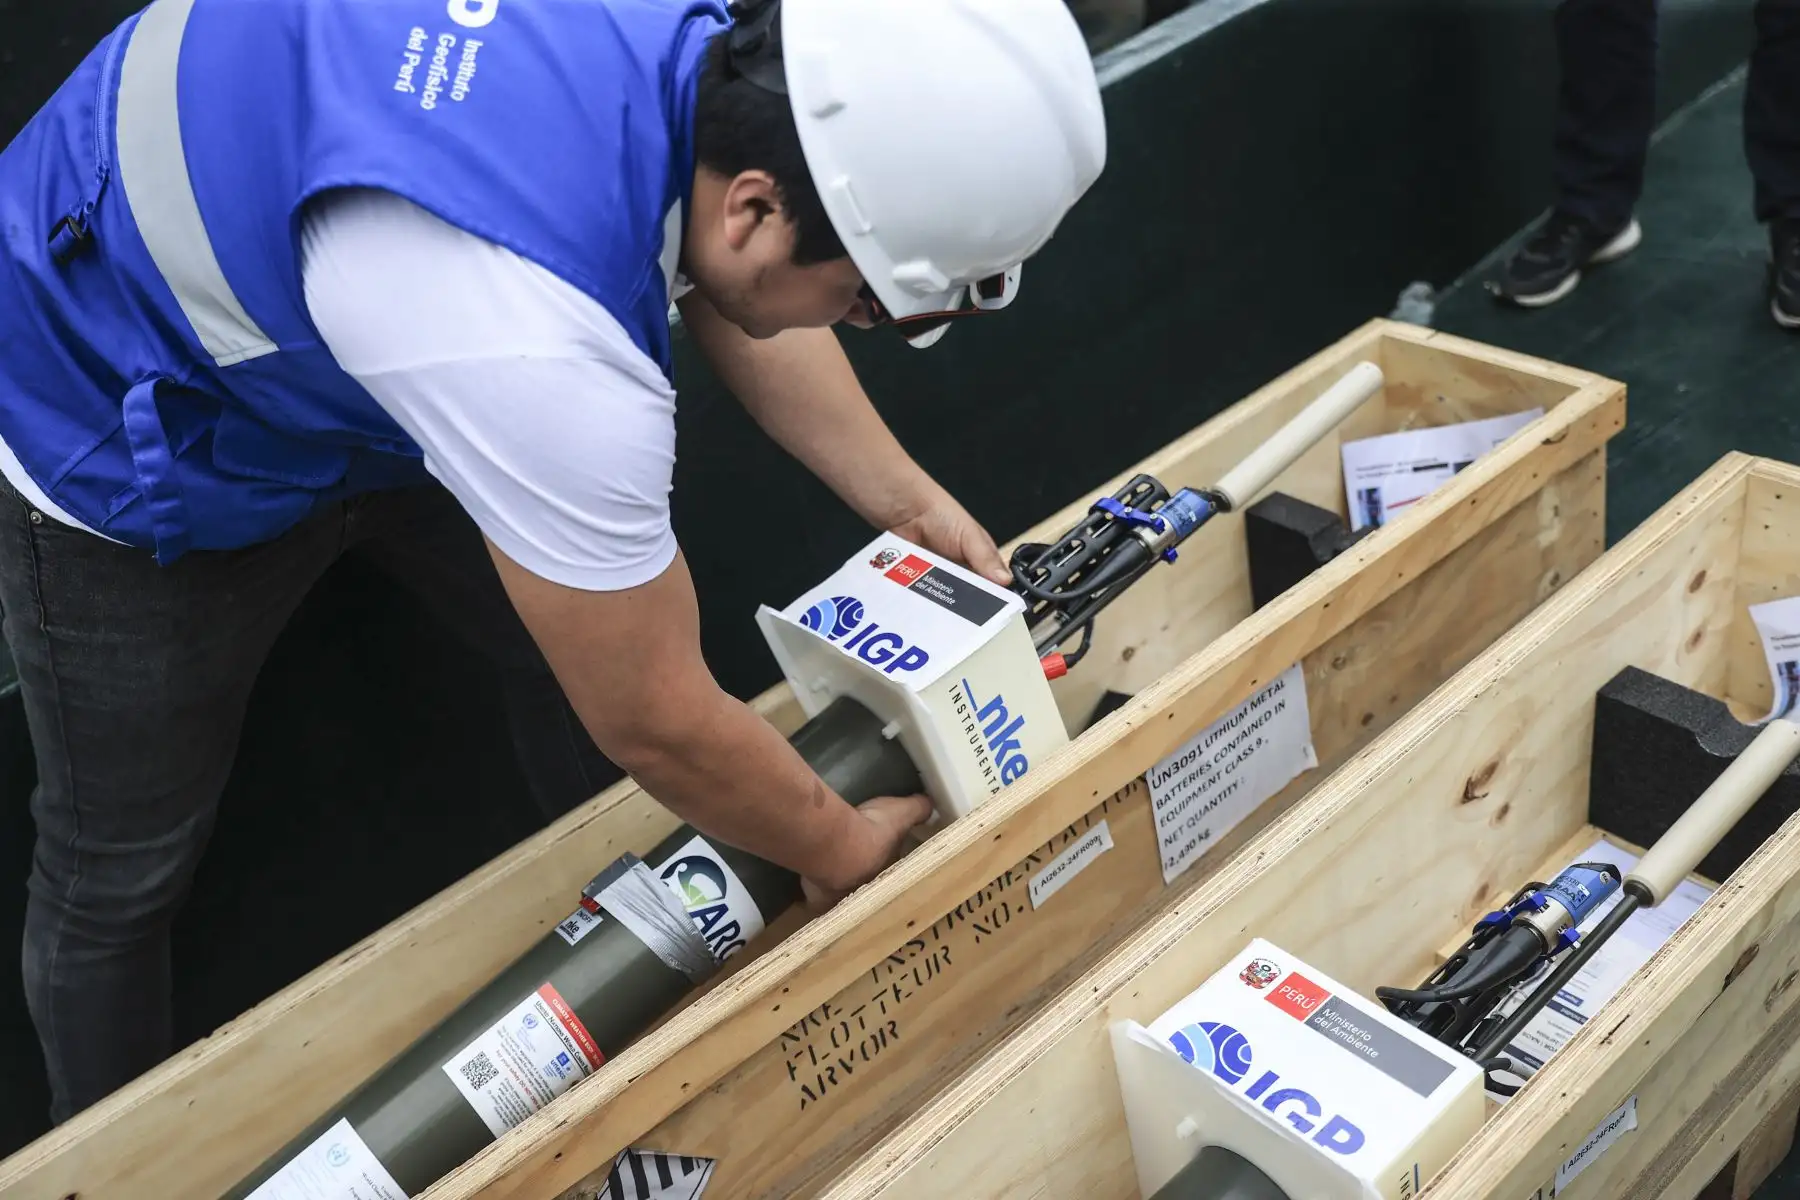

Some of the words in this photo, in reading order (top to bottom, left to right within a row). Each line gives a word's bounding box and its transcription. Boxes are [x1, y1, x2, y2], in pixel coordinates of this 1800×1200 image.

[406, 27, 428, 52] del
[393, 51, 421, 94] Perú
[450, 39, 483, 101] Instituto
[895, 564, 920, 579] PERÚ
[915, 580, 926, 590] del
[926, 586, 956, 605] Ambiente
[923, 575, 954, 594] Ministerio
[844, 623, 929, 675] IGP
[1152, 746, 1204, 790] UN3091
[1204, 708, 1248, 748] LITHIUM
[1250, 681, 1286, 712] METAL
[1156, 761, 1212, 810] BATTERIES
[1214, 712, 1272, 763] CONTAINED
[1274, 700, 1286, 718] IN
[1159, 771, 1223, 828] EQUIPMENT
[1224, 746, 1254, 777] CLASS
[1163, 829, 1184, 848] NET
[566, 920, 580, 933] nke
[786, 945, 952, 1082] FLOTTEUR
[1278, 983, 1318, 1010] PERÚ
[1314, 1015, 1333, 1032] del
[1330, 1024, 1379, 1059] Ambiente
[1321, 1007, 1372, 1042] Ministerio
[549, 1058, 566, 1080] unesco
[800, 1020, 900, 1111] ARVOR
[1244, 1069, 1366, 1155] IGP
